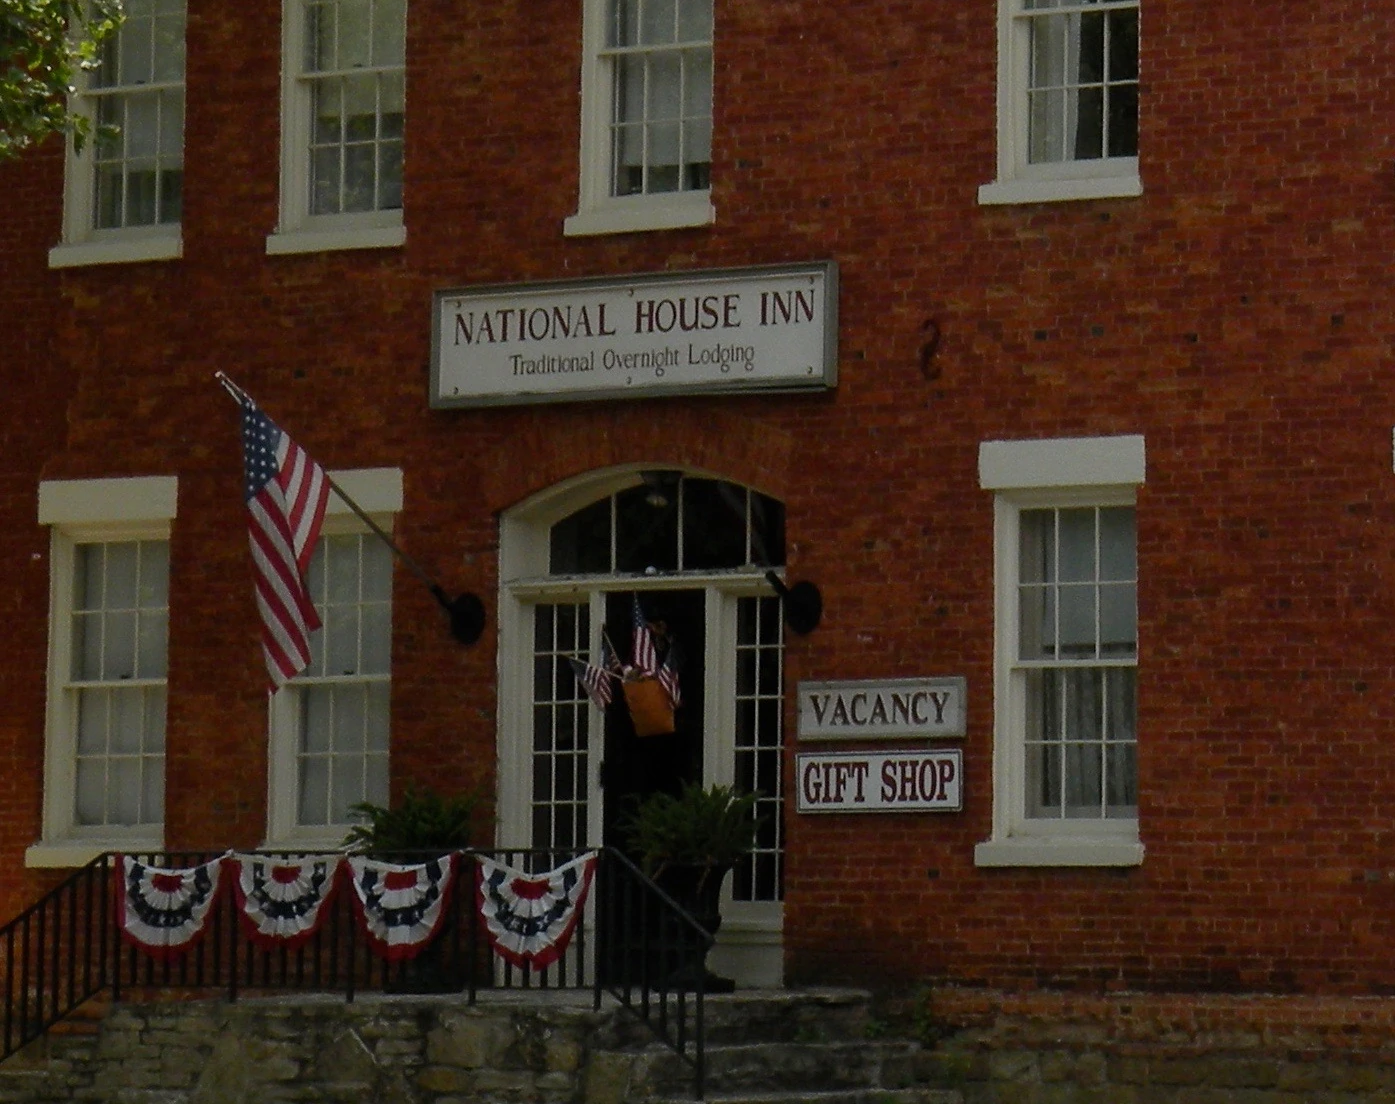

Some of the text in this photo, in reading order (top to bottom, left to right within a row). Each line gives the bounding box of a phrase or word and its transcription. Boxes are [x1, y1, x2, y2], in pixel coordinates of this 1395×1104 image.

[453, 289, 816, 346] NATIONAL HOUSE INN
[509, 343, 755, 377] Traditional Overnight Lodging
[809, 691, 951, 726] VACANCY
[803, 759, 955, 804] GIFT SHOP
